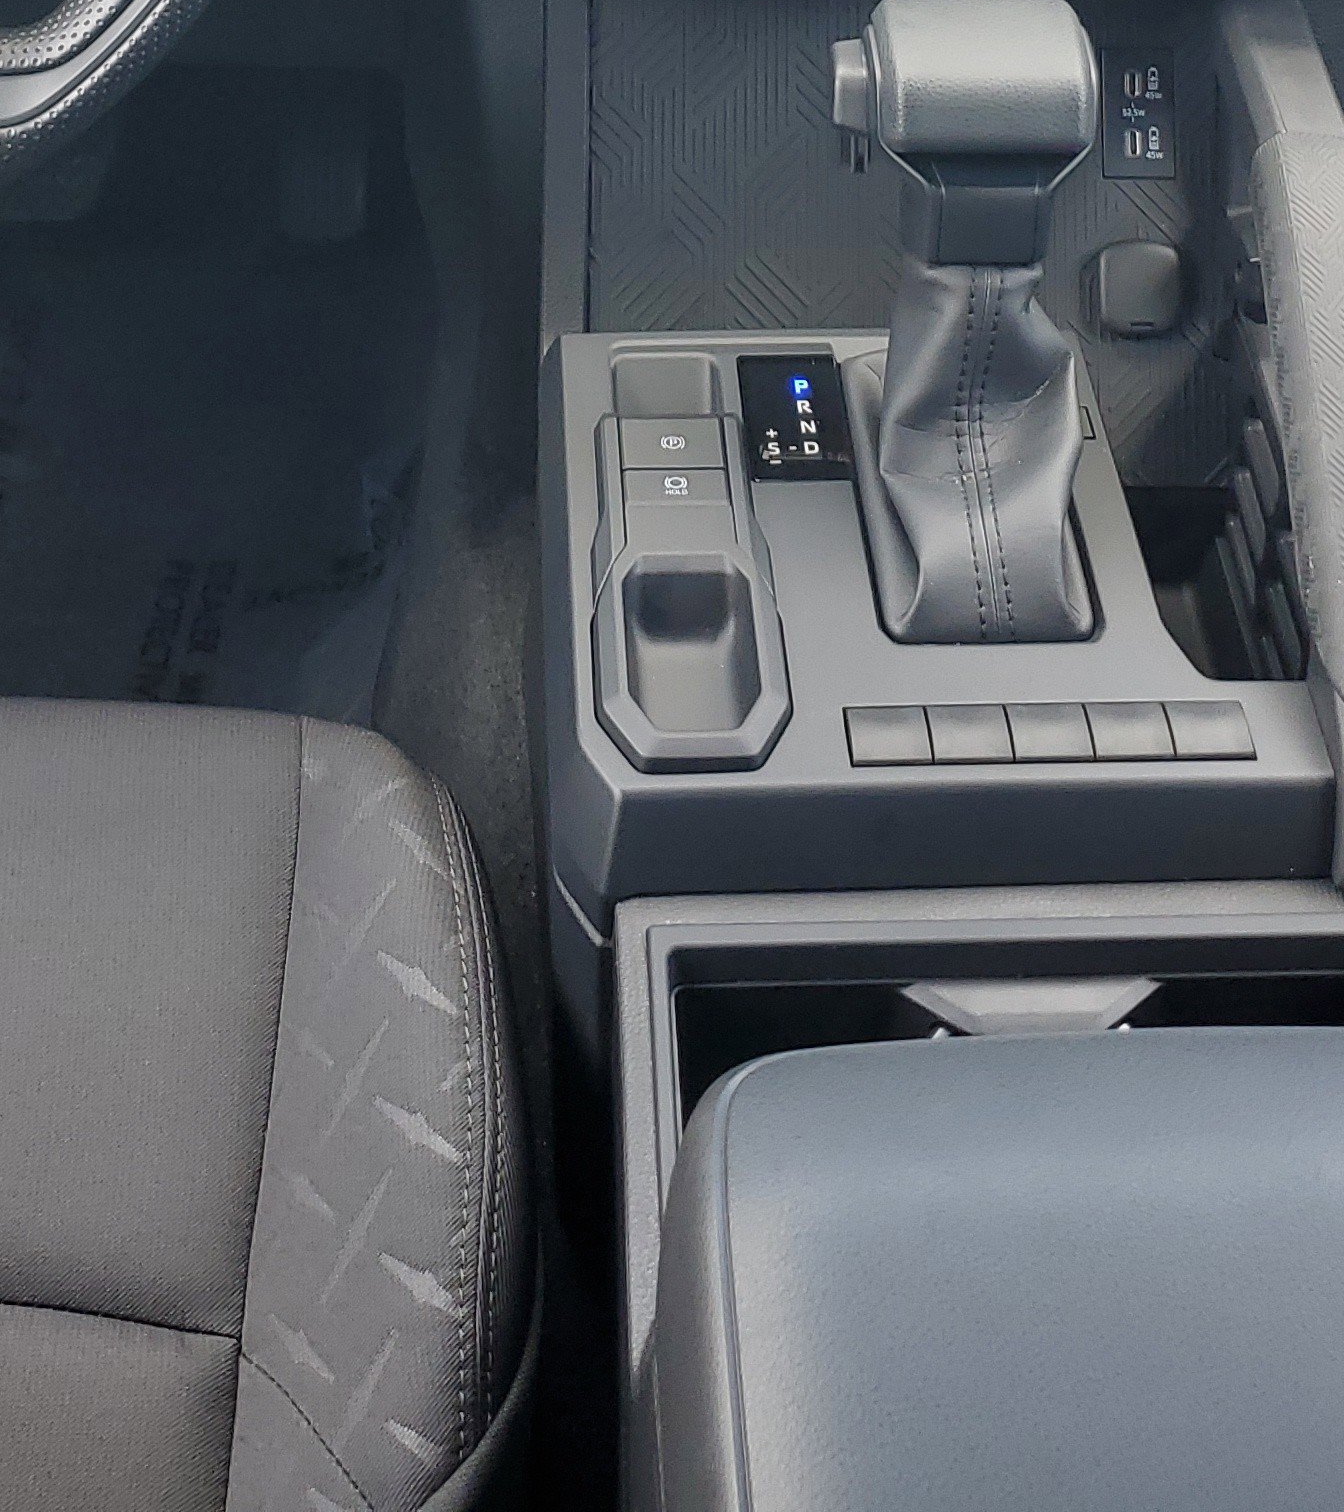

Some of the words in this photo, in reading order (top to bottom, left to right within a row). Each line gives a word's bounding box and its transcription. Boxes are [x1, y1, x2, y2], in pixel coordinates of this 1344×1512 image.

[794, 379, 809, 395] P
[796, 399, 813, 414] R
[800, 420, 817, 434] N
[767, 441, 781, 455] S
[804, 441, 820, 455] D
